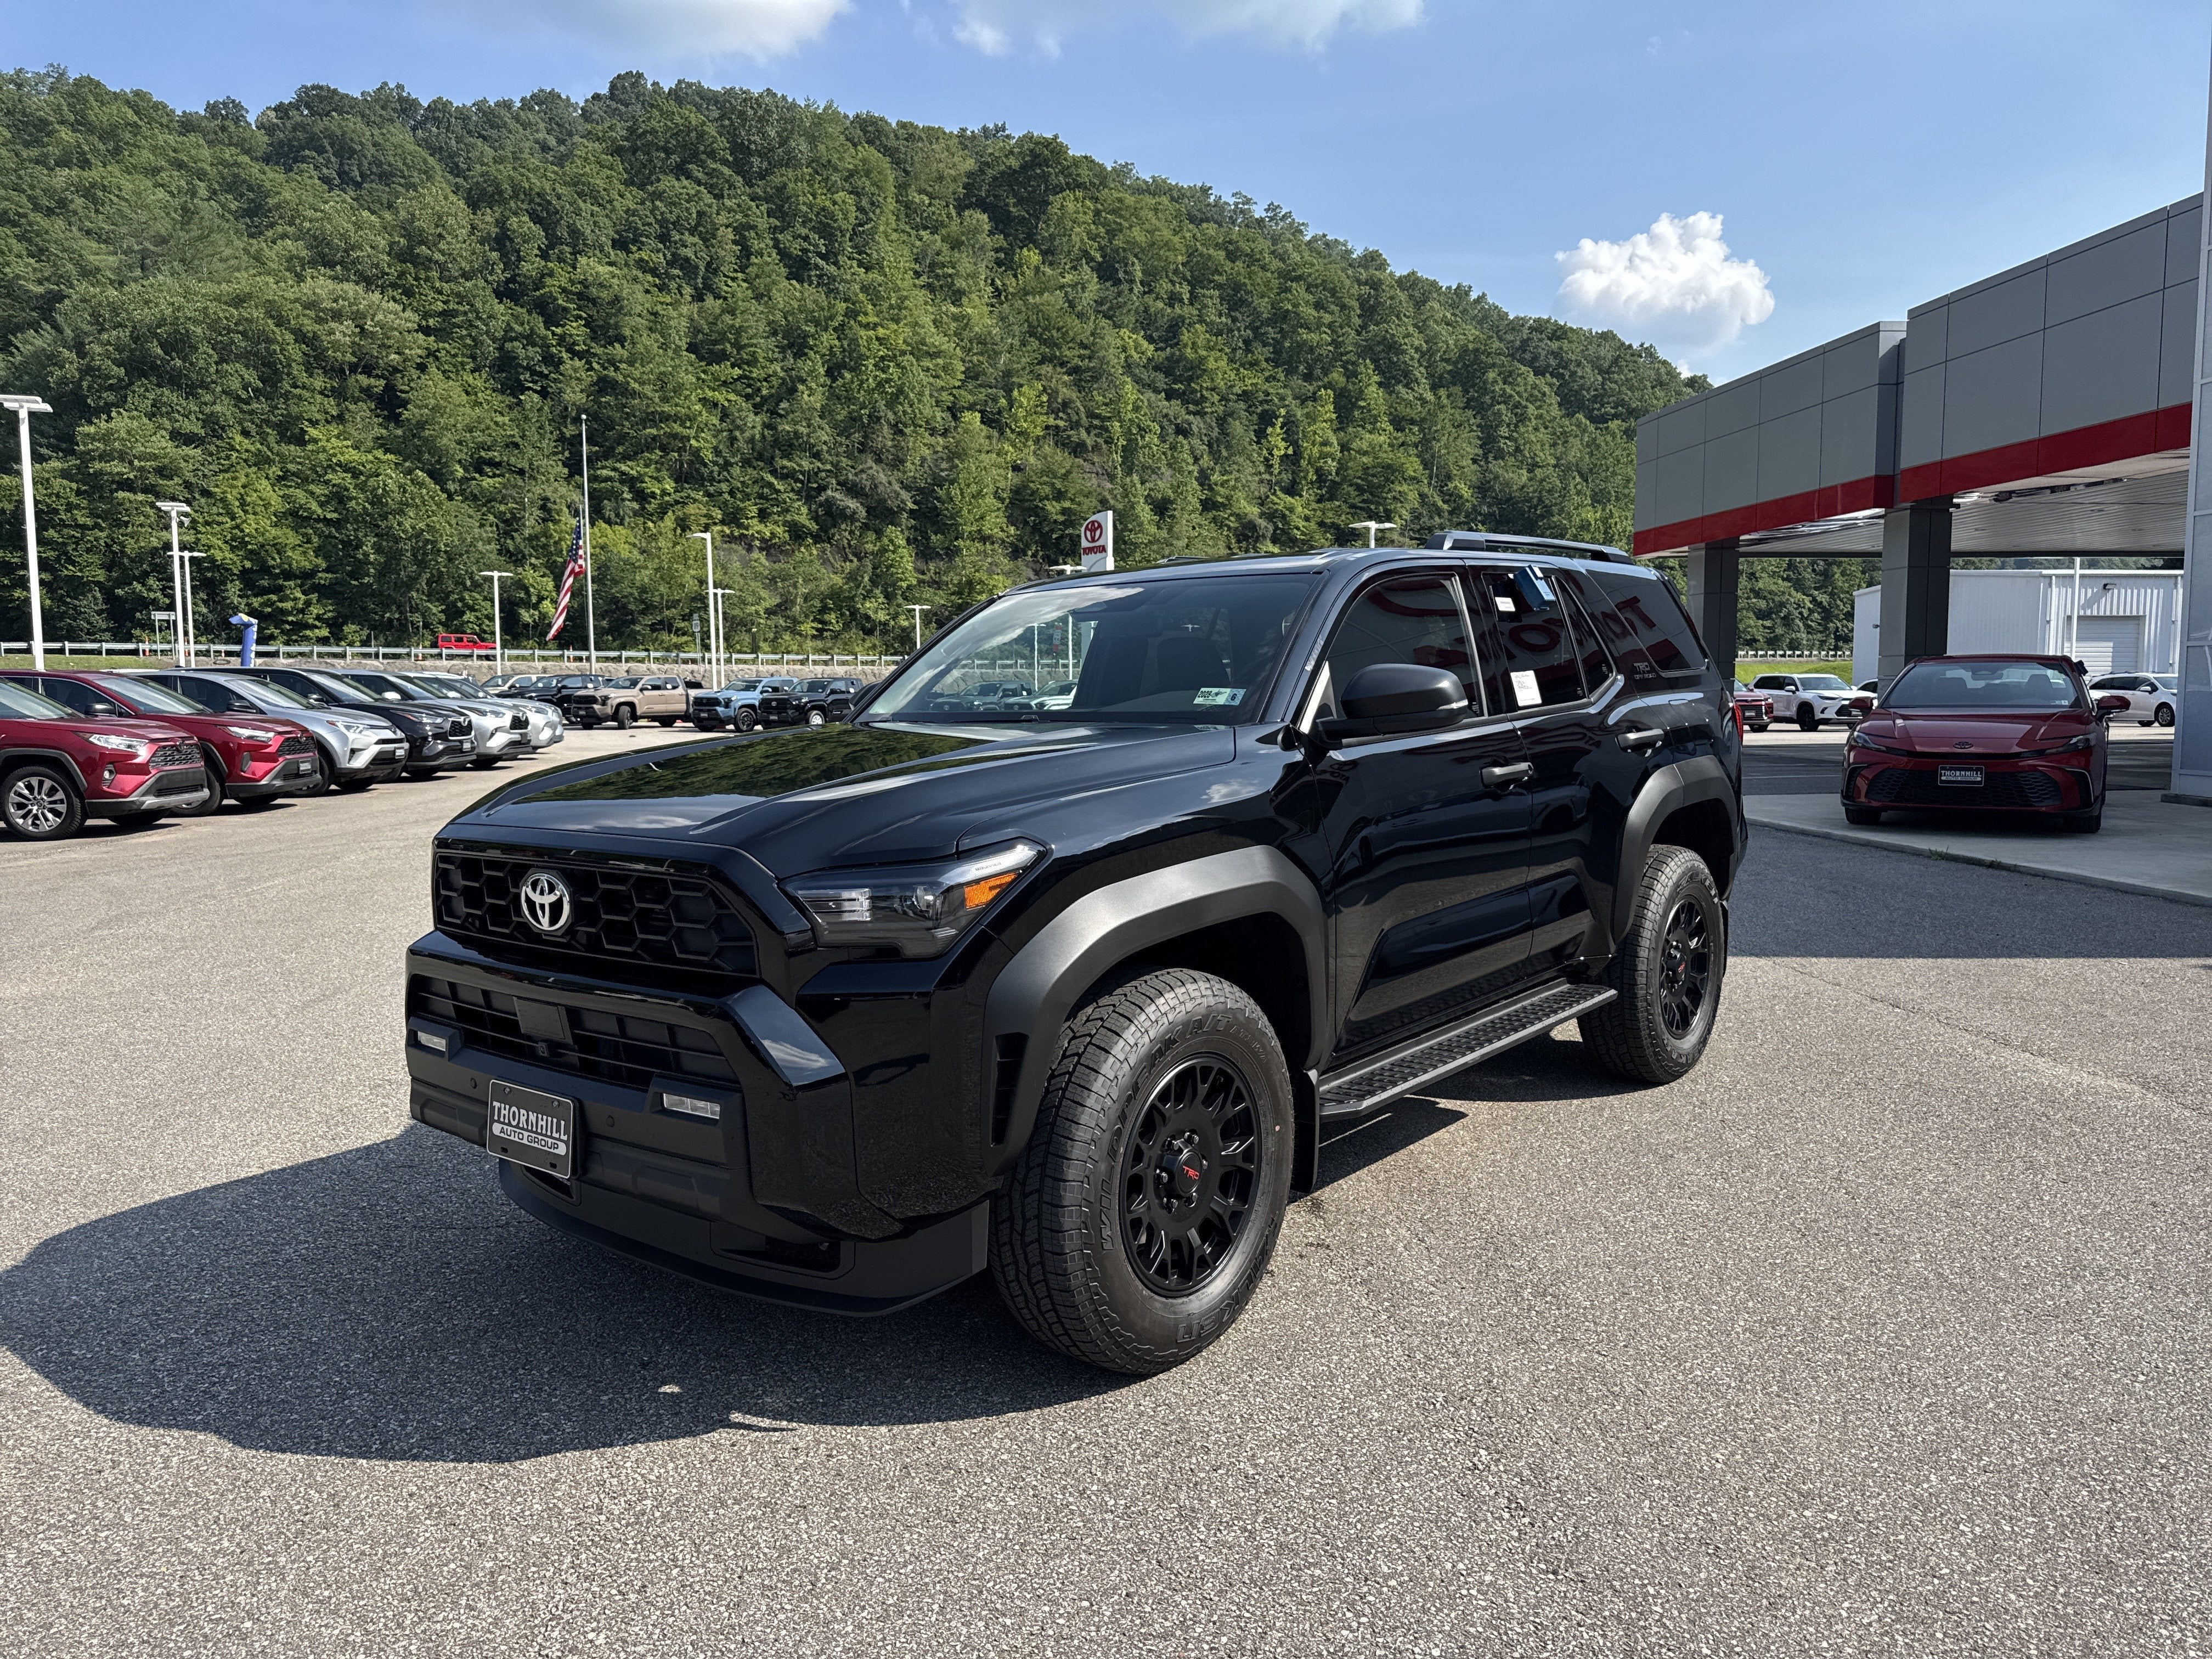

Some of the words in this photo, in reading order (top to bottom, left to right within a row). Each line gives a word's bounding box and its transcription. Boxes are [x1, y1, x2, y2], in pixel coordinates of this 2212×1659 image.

[1081, 545, 1106, 556] TOYOTA
[1634, 662, 1650, 674] TRD
[493, 1101, 568, 1141] THORNHILL
[499, 1126, 524, 1141] AUTO
[527, 1134, 559, 1151] GROUP
[1183, 1165, 1200, 1180] TRD
